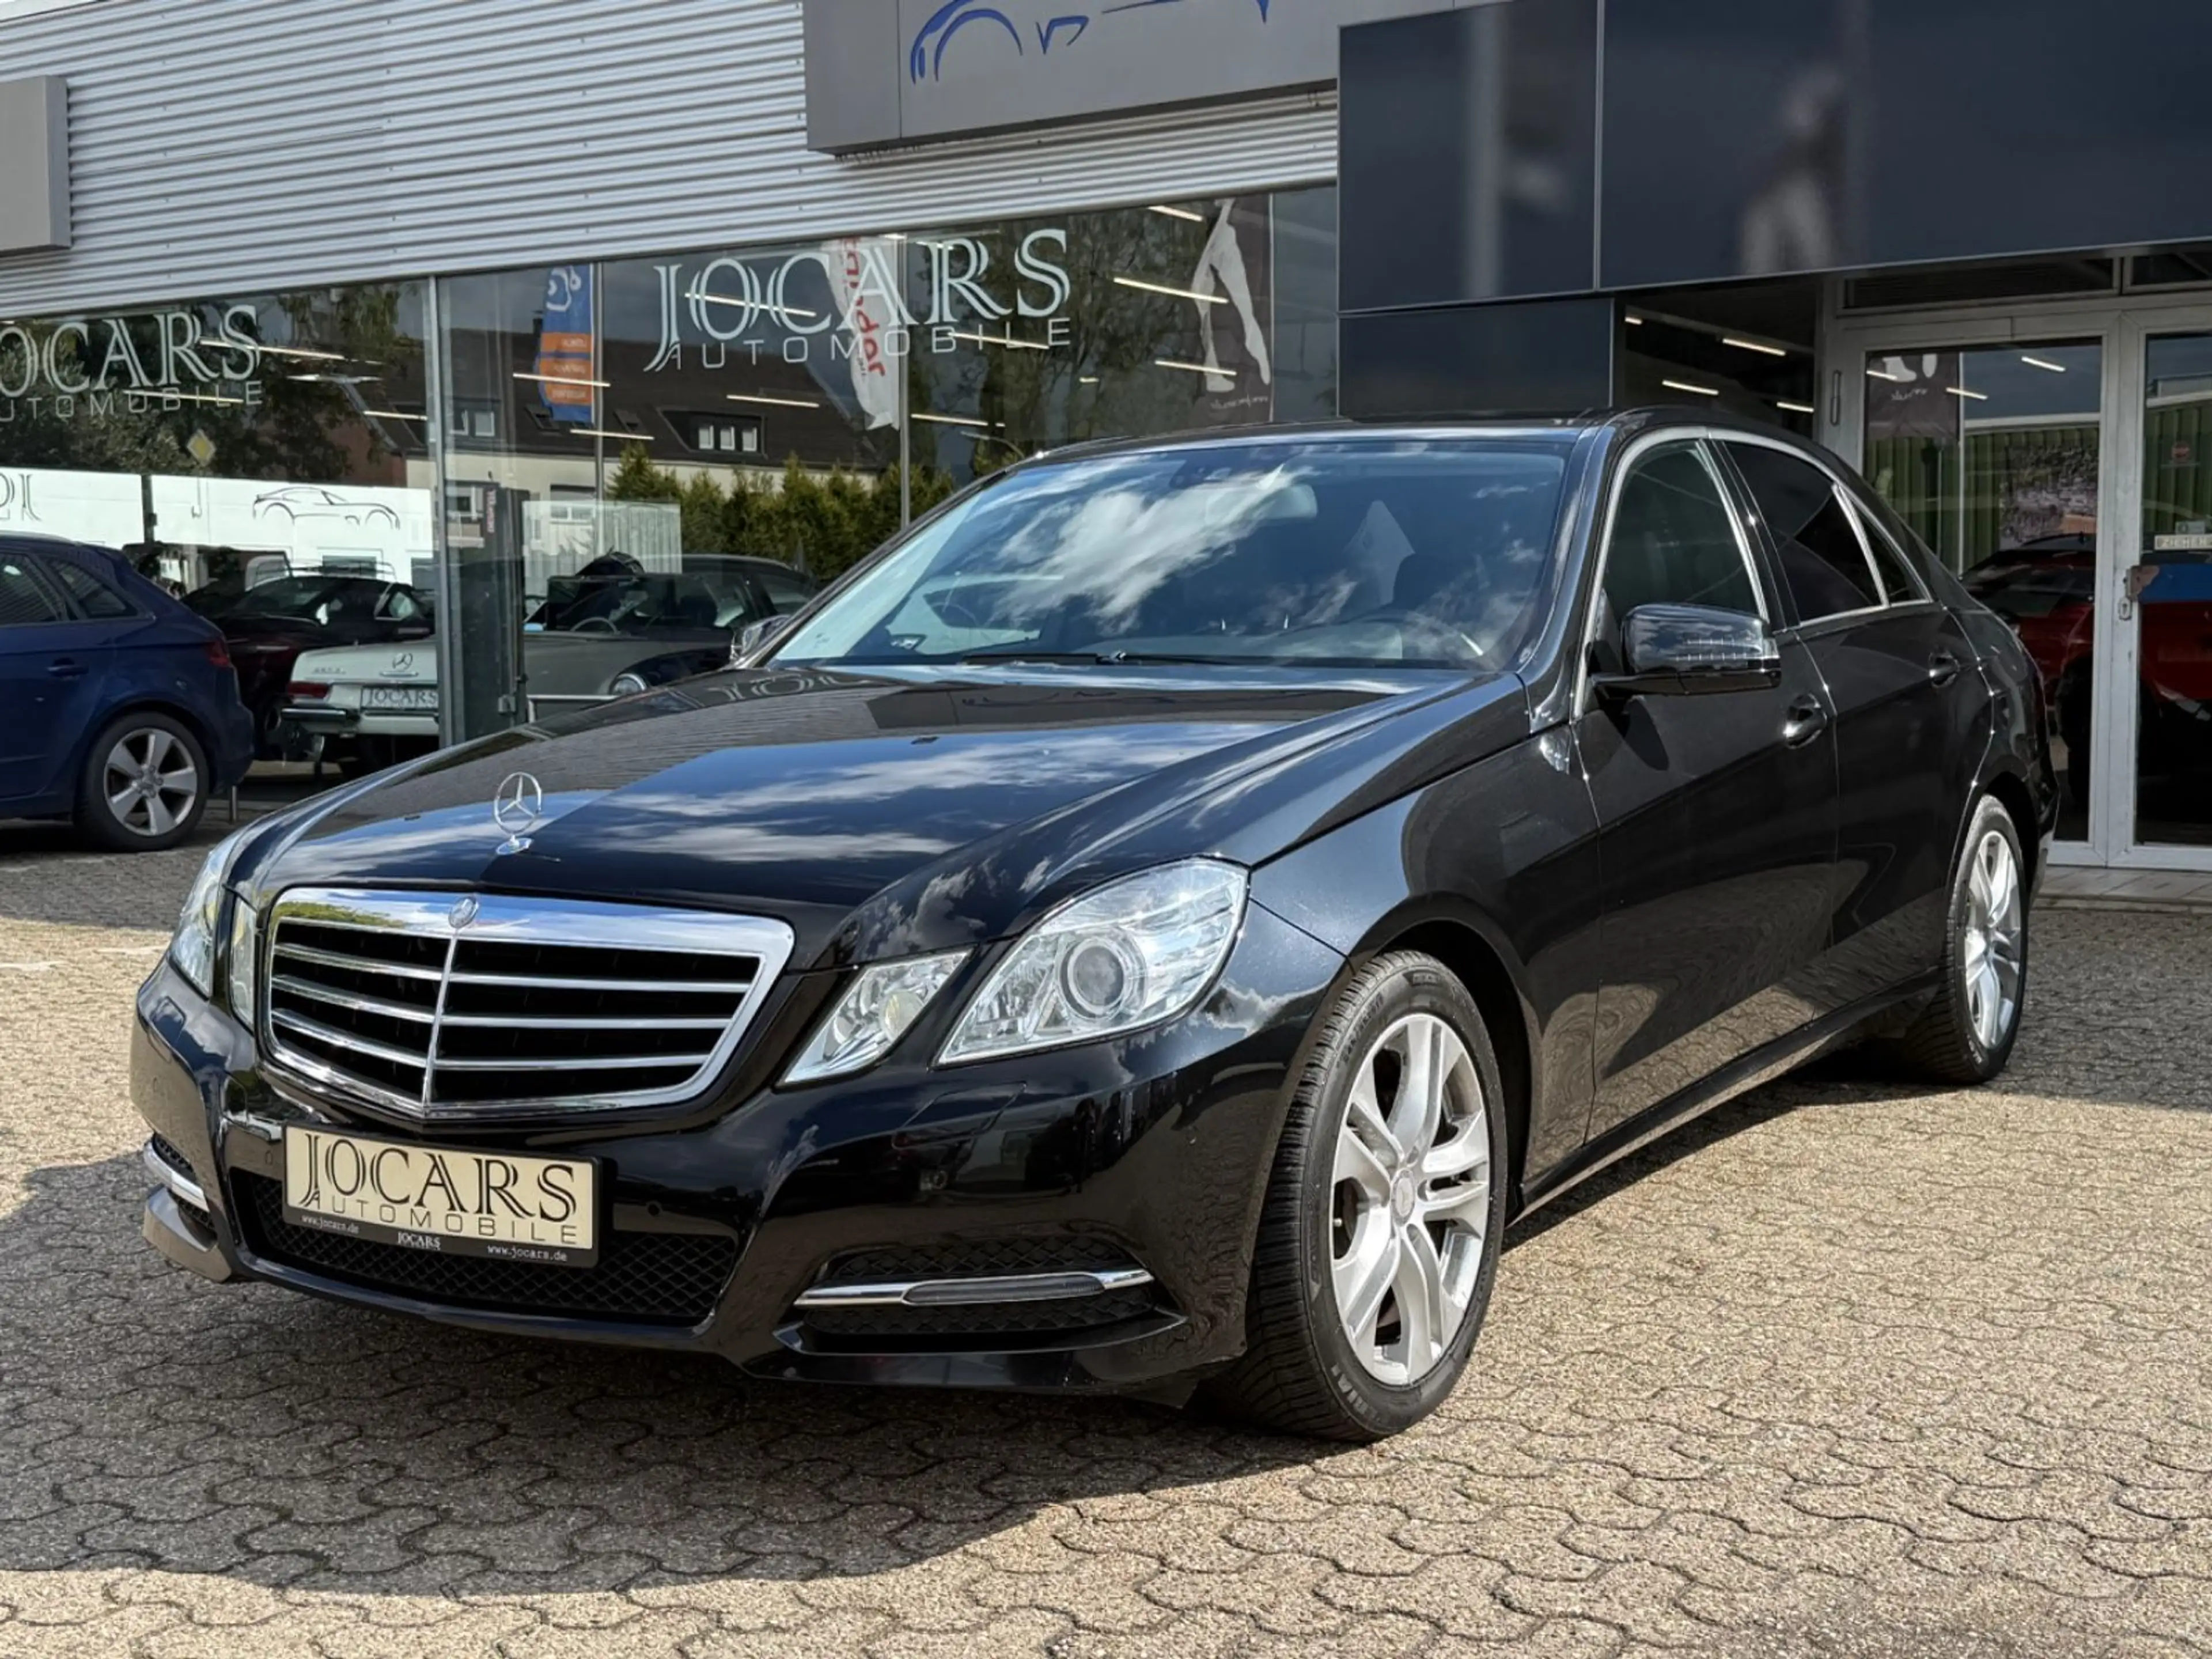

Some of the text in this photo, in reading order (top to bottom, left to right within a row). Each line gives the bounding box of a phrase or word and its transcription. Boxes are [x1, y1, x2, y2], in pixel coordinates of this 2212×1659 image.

[643, 229, 1071, 372] JOCARS
[658, 317, 1071, 370] AUTOMOBILE
[300, 1134, 577, 1223] JOCARS
[309, 1190, 577, 1245] AUTOMOBILE
[397, 1231, 441, 1248] JOCARS
[487, 1245, 567, 1262] www.jocars.de
